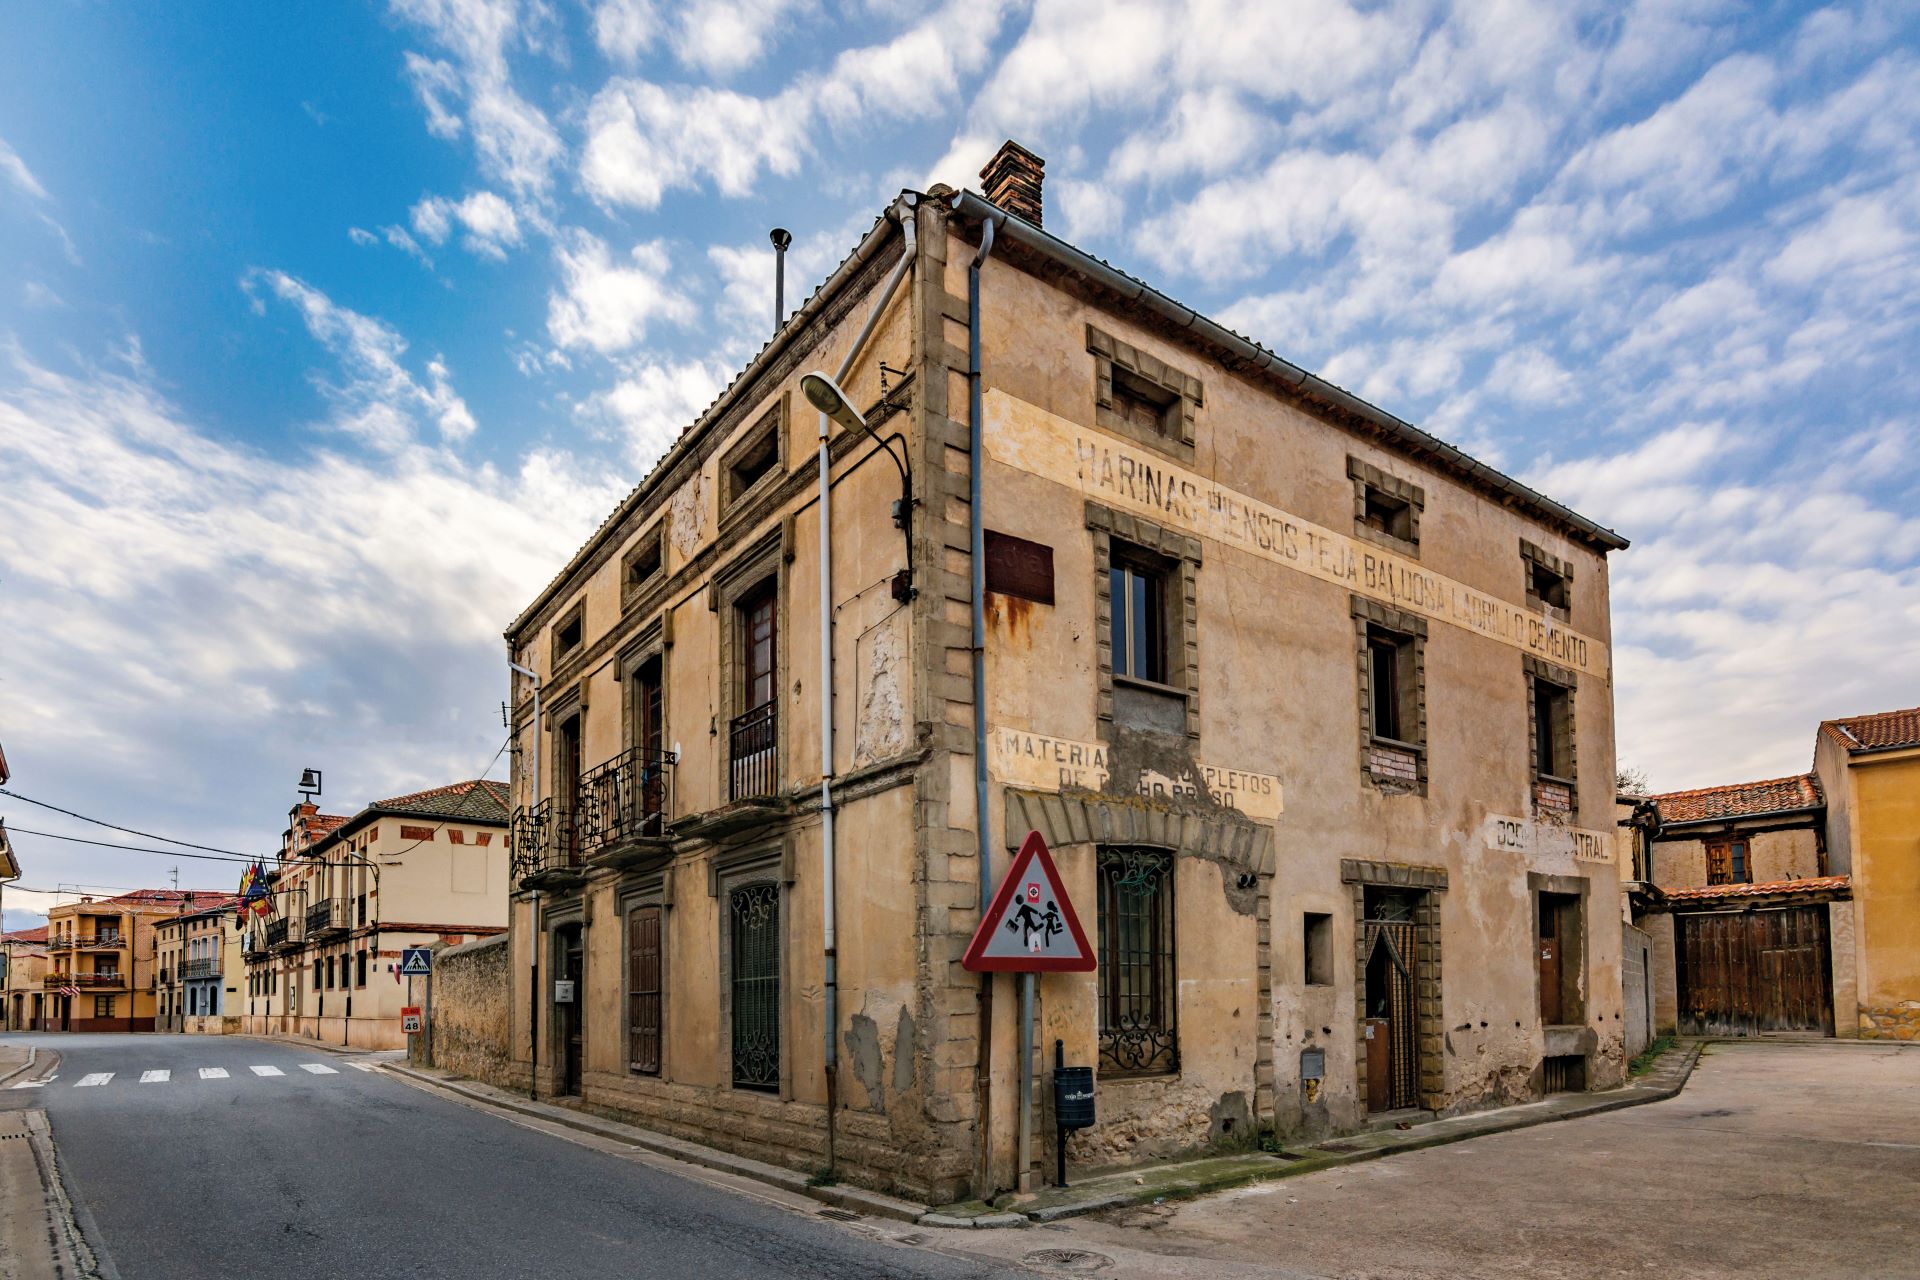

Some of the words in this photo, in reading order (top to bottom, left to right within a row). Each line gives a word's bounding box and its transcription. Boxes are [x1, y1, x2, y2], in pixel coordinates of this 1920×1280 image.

[1076, 436, 1198, 522] HARINAS
[1305, 531, 1357, 581] TEJA
[1528, 618, 1587, 667] CEMENTO
[1005, 733, 1105, 769] MATERIA
[1567, 831, 1609, 860] NTRAL
[405, 1023, 419, 1031] 48
